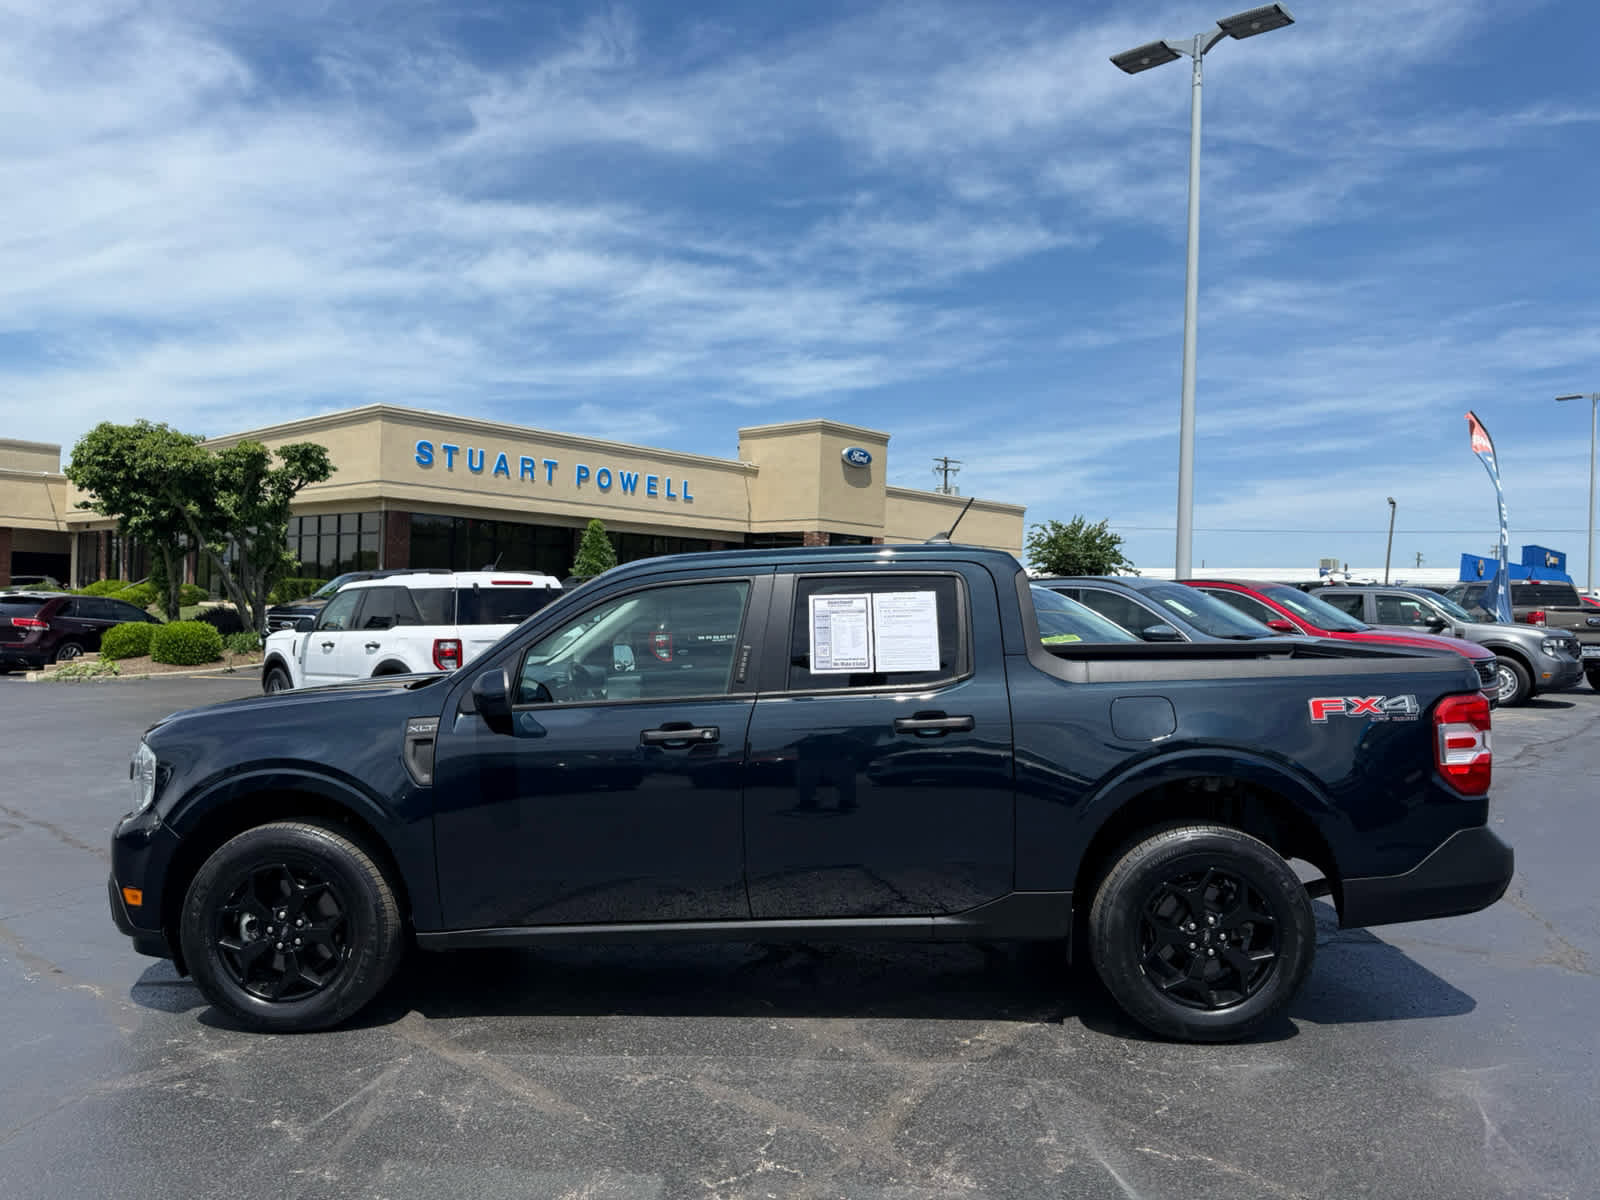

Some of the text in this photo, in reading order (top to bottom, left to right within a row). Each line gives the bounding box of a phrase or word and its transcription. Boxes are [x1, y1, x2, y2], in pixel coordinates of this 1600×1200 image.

[414, 440, 694, 501] STUART POWELL
[1308, 695, 1420, 723] FX4
[408, 724, 434, 733] XLT
